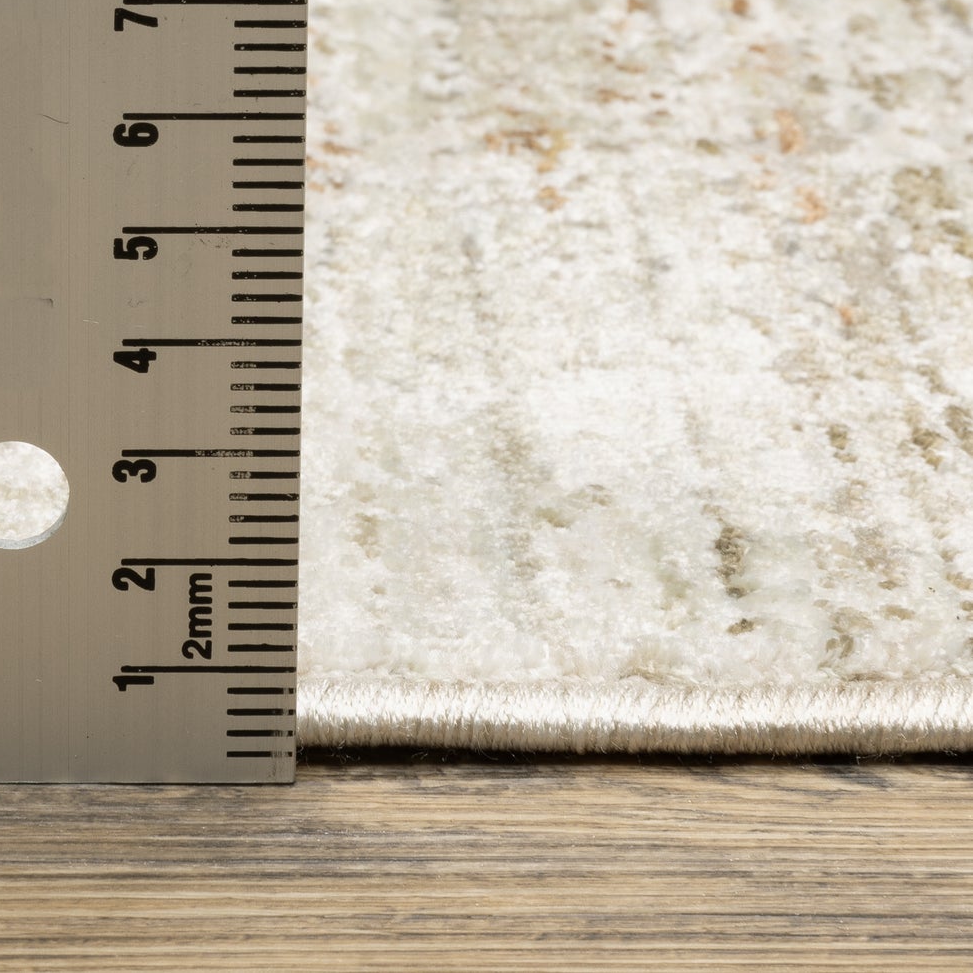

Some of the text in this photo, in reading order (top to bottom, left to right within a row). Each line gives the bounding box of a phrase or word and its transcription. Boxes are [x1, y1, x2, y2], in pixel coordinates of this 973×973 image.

[113, 7, 159, 32] 7
[112, 122, 159, 148] 6
[112, 235, 159, 261] 5
[112, 347, 157, 374] 4
[111, 458, 157, 484] 3
[111, 567, 156, 592] 2
[181, 572, 213, 660] 2mm
[111, 674, 155, 692] 1
